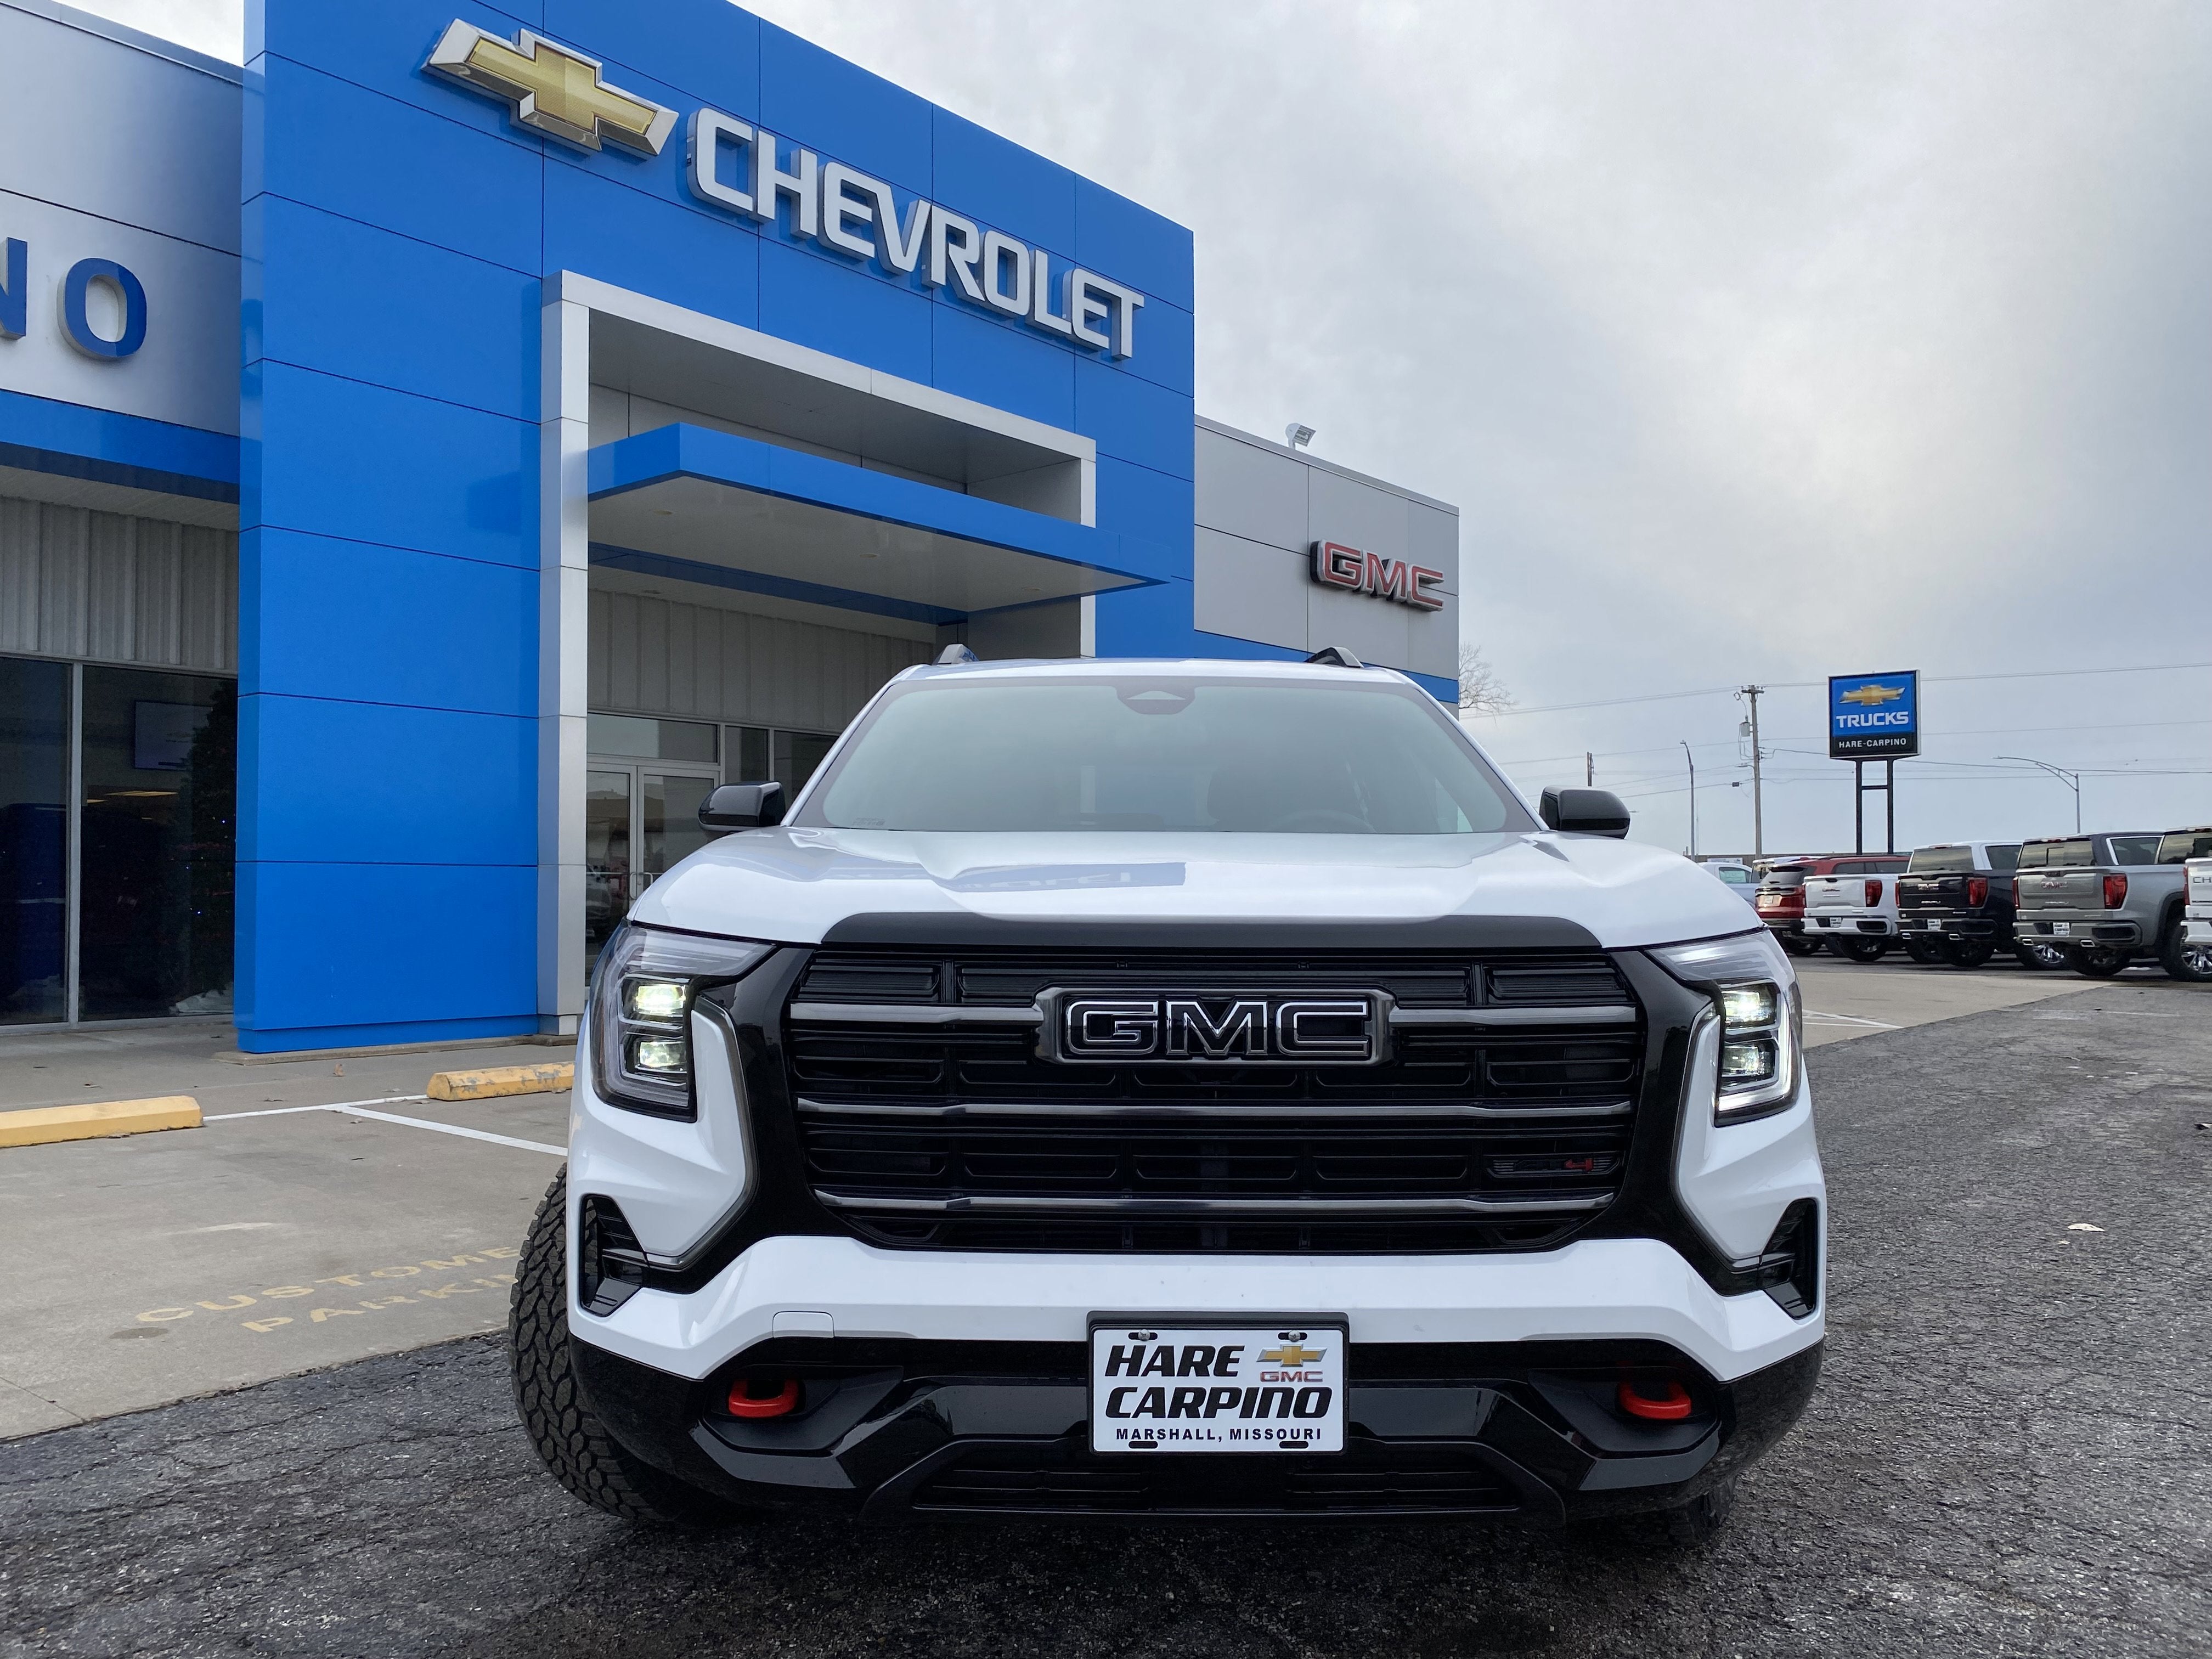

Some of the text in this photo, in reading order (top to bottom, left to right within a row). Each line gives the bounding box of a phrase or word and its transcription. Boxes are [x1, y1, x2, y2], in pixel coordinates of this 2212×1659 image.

[687, 108, 1144, 360] CHEVROLET
[1314, 539, 1444, 611] GMC
[1836, 711, 1909, 728] TRUCKS
[1067, 1001, 1369, 1056] GMC
[1104, 1345, 1245, 1377] HARE
[1260, 1370, 1324, 1383] GMC
[1105, 1386, 1333, 1419] CARPINO
[1116, 1428, 1321, 1442] MARSHALL, MISSOURI
